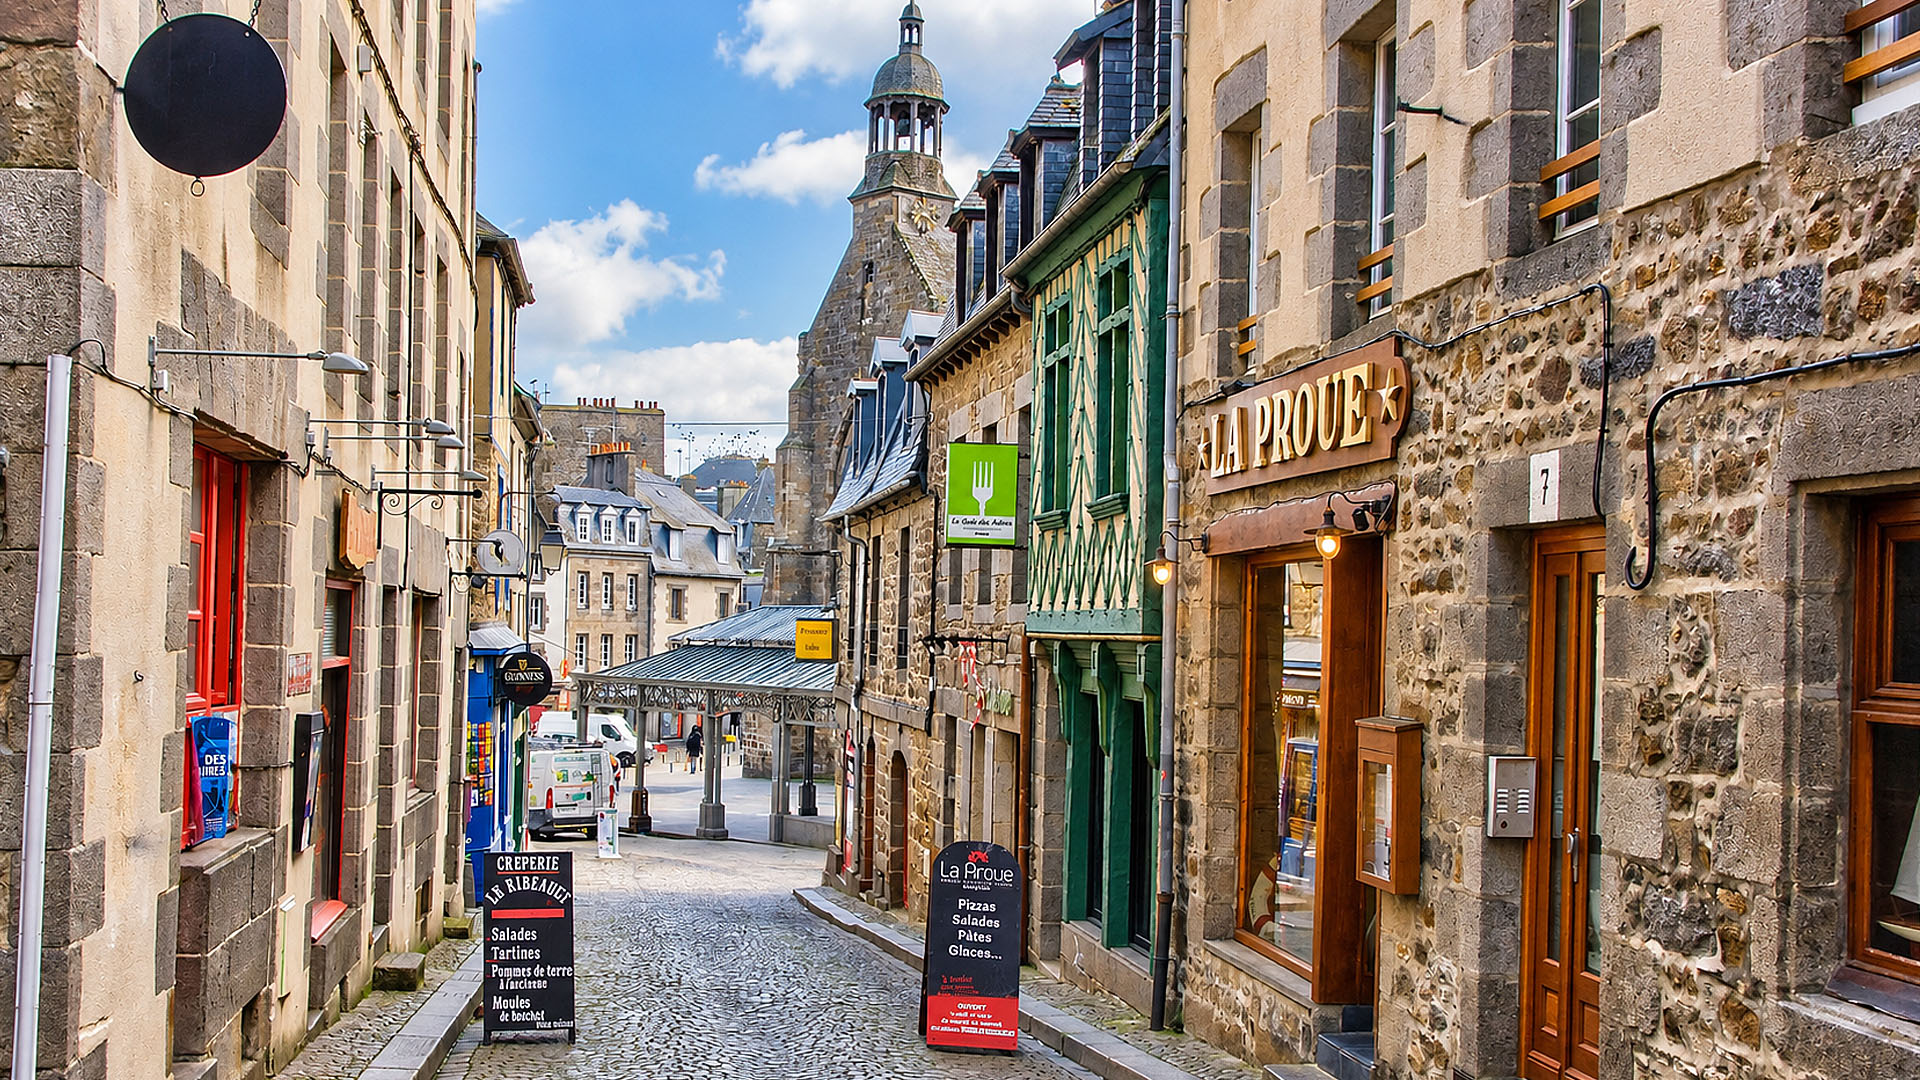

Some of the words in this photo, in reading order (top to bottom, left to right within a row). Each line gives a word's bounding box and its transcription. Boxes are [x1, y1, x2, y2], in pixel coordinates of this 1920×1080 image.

[1210, 407, 1248, 479] LA
[1253, 361, 1376, 470] PROUE
[1540, 467, 1550, 506] 7
[204, 754, 227, 766] DES
[496, 856, 560, 871] CREPERIE
[940, 860, 960, 879] La
[964, 862, 1014, 883] Proue
[484, 884, 506, 906] LE
[958, 898, 997, 913] Pizzas
[952, 914, 1000, 929] Salades
[491, 927, 538, 941] Salades
[491, 945, 541, 960] Tartines
[491, 964, 532, 978] Pommes
[533, 964, 545, 978] de
[546, 965, 574, 977] terre
[492, 995, 531, 1010] Moules
[499, 1010, 510, 1022] de
